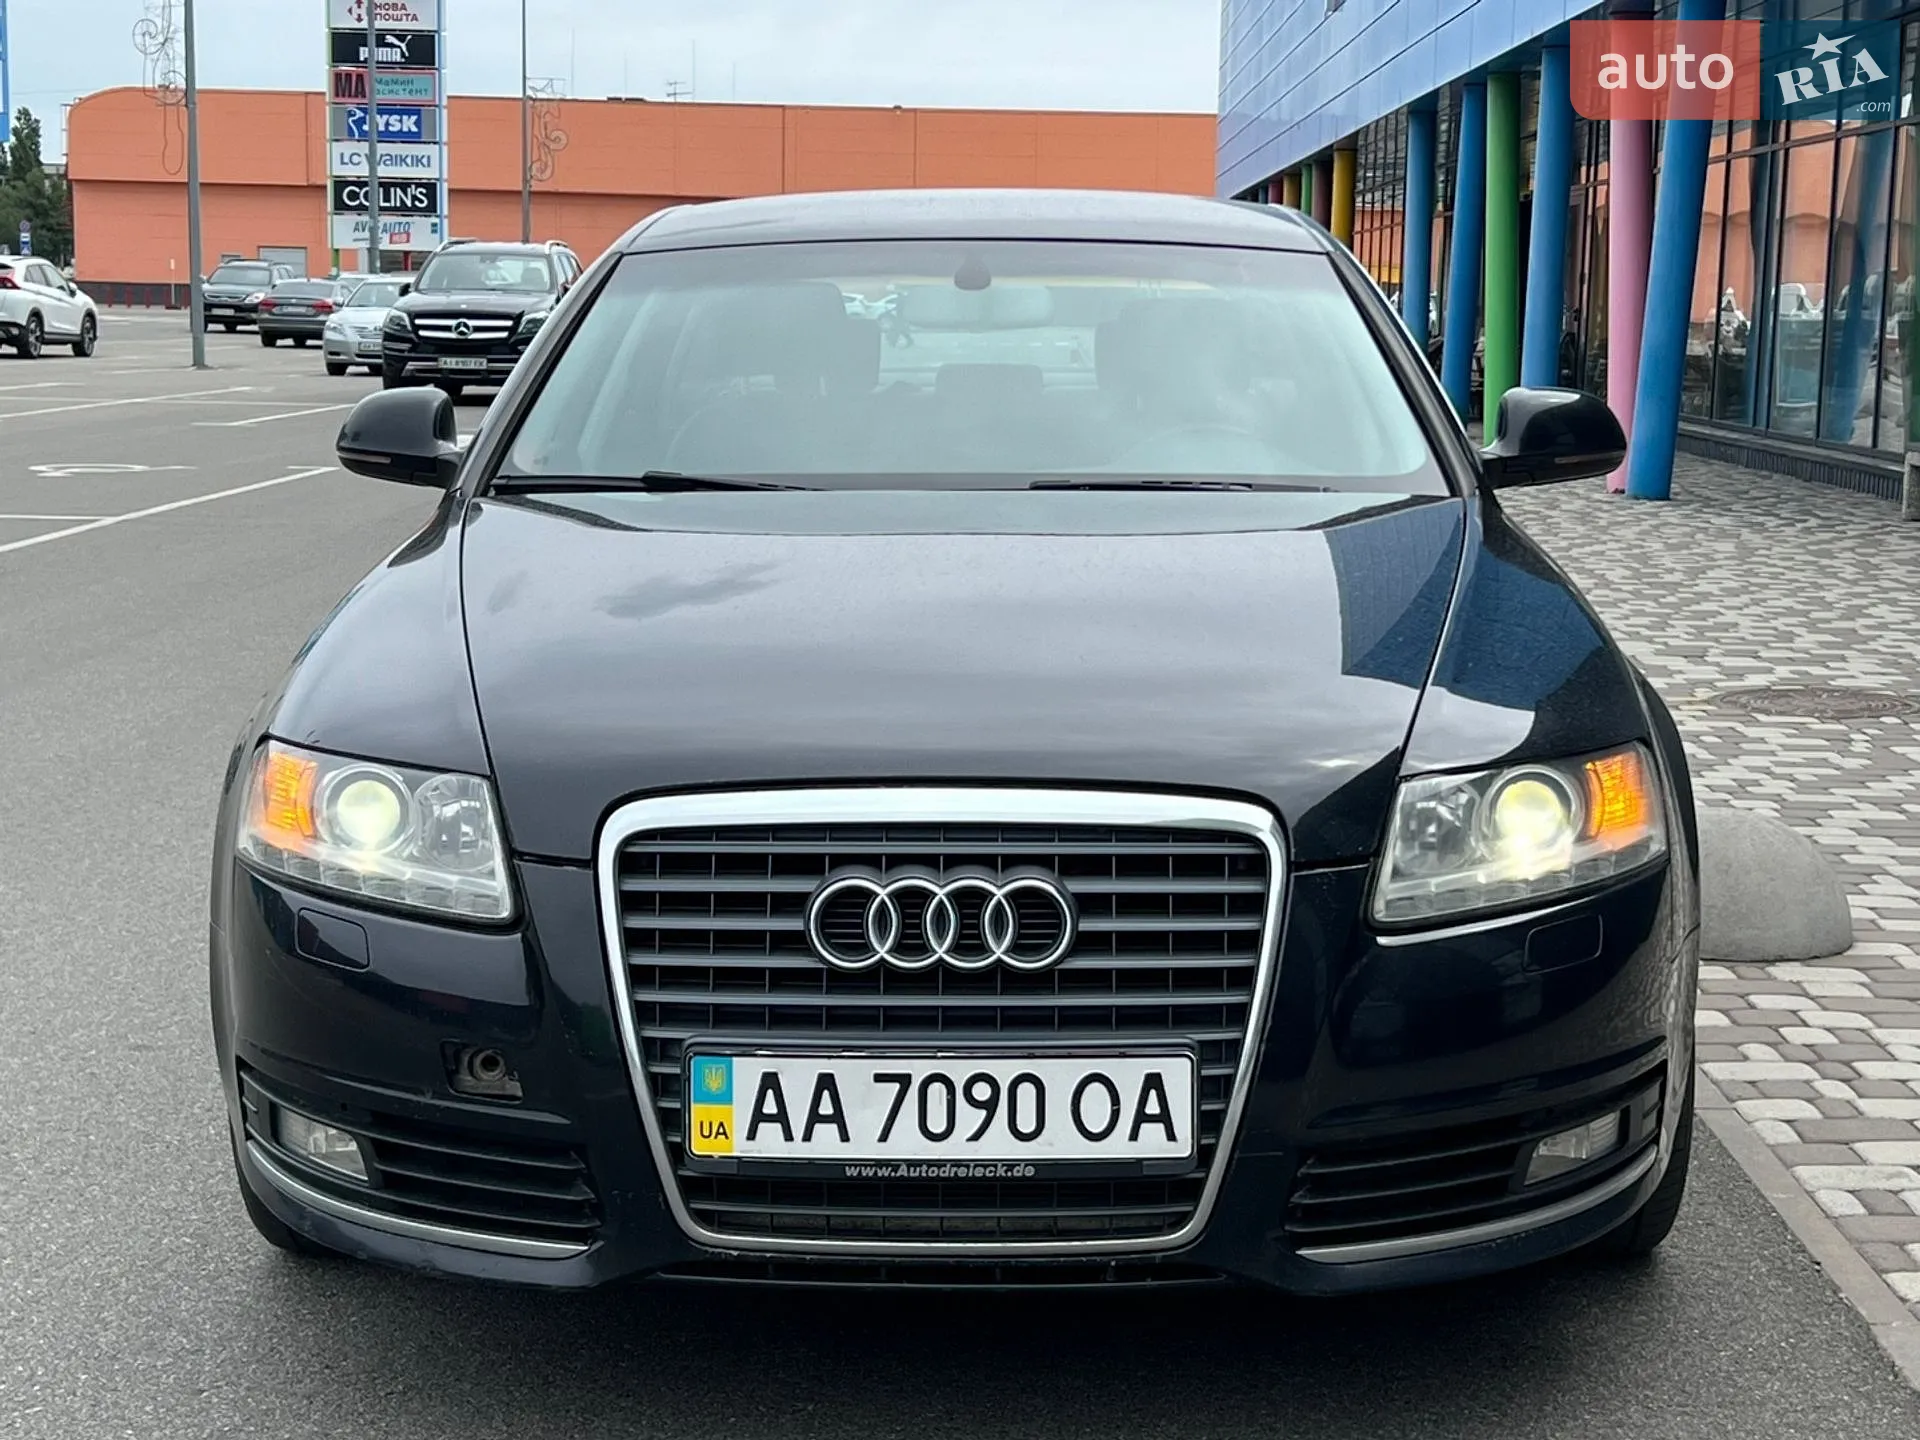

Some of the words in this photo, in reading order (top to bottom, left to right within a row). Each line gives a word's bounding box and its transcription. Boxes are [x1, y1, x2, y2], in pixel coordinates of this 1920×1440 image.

[374, 2, 407, 12] НОВА
[374, 13, 419, 22] ПОШТА
[359, 46, 402, 62] PMA
[340, 152, 362, 166] LC
[746, 1071, 851, 1143] AA
[873, 1072, 1046, 1143] 7090
[1070, 1072, 1178, 1143] OA
[699, 1121, 730, 1140] UA
[844, 1162, 1036, 1178] www.Autodreieck.de
